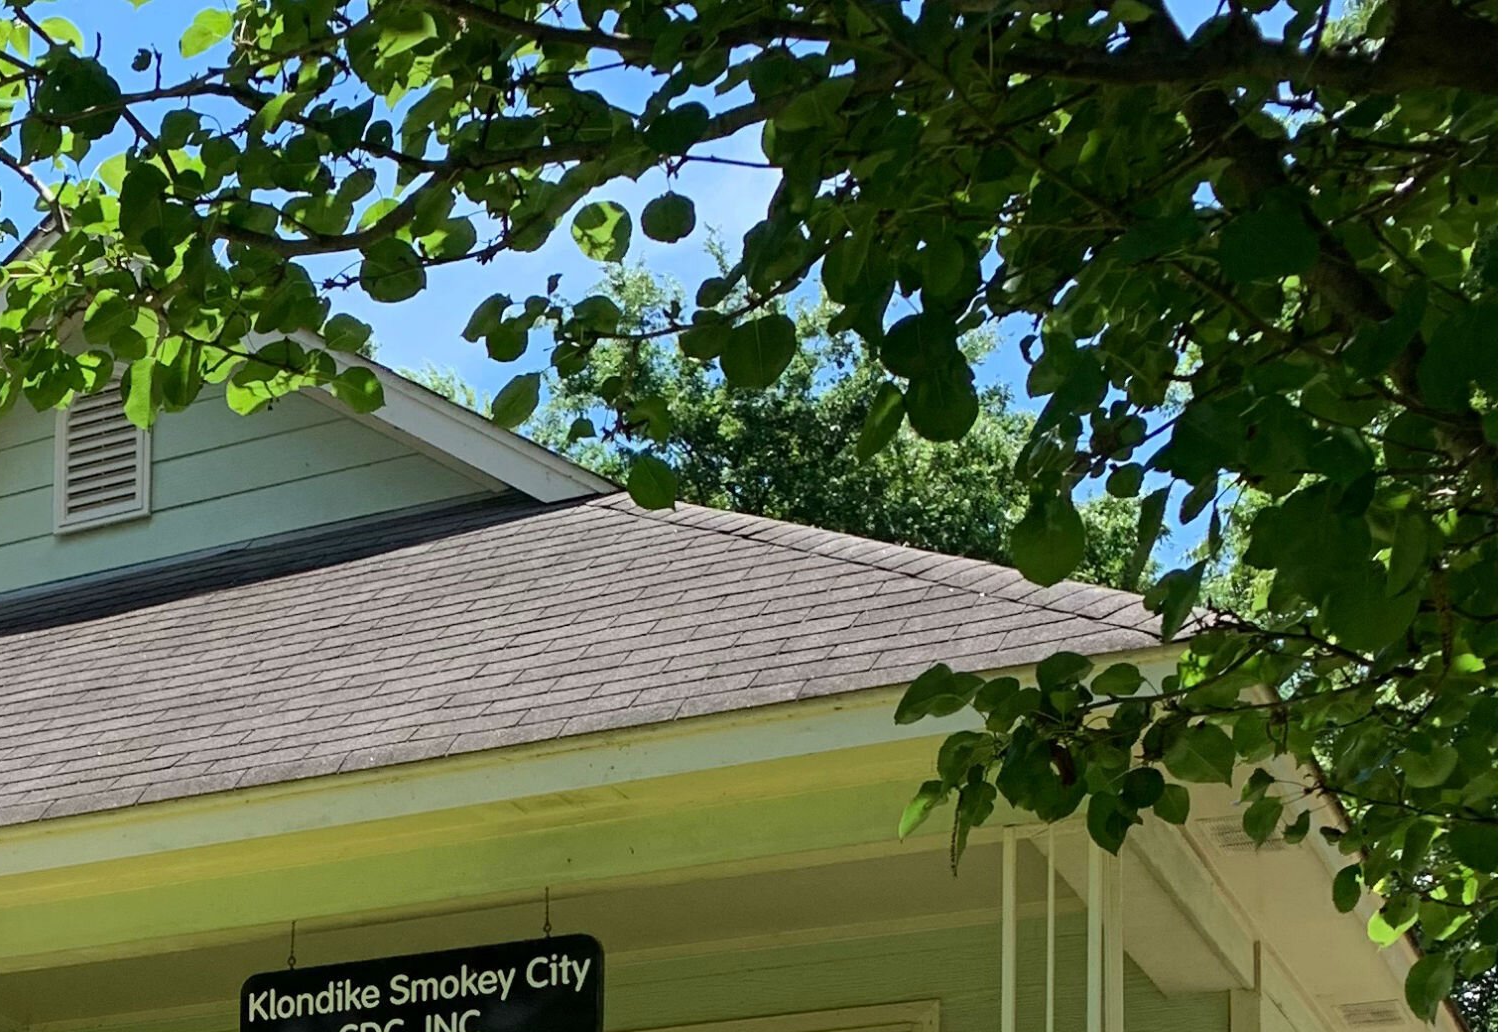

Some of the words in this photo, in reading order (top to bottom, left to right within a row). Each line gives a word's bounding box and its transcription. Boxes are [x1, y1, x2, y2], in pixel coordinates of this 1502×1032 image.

[248, 980, 381, 1022] Klondike
[389, 964, 517, 1006] Smokey
[525, 953, 592, 992] City
